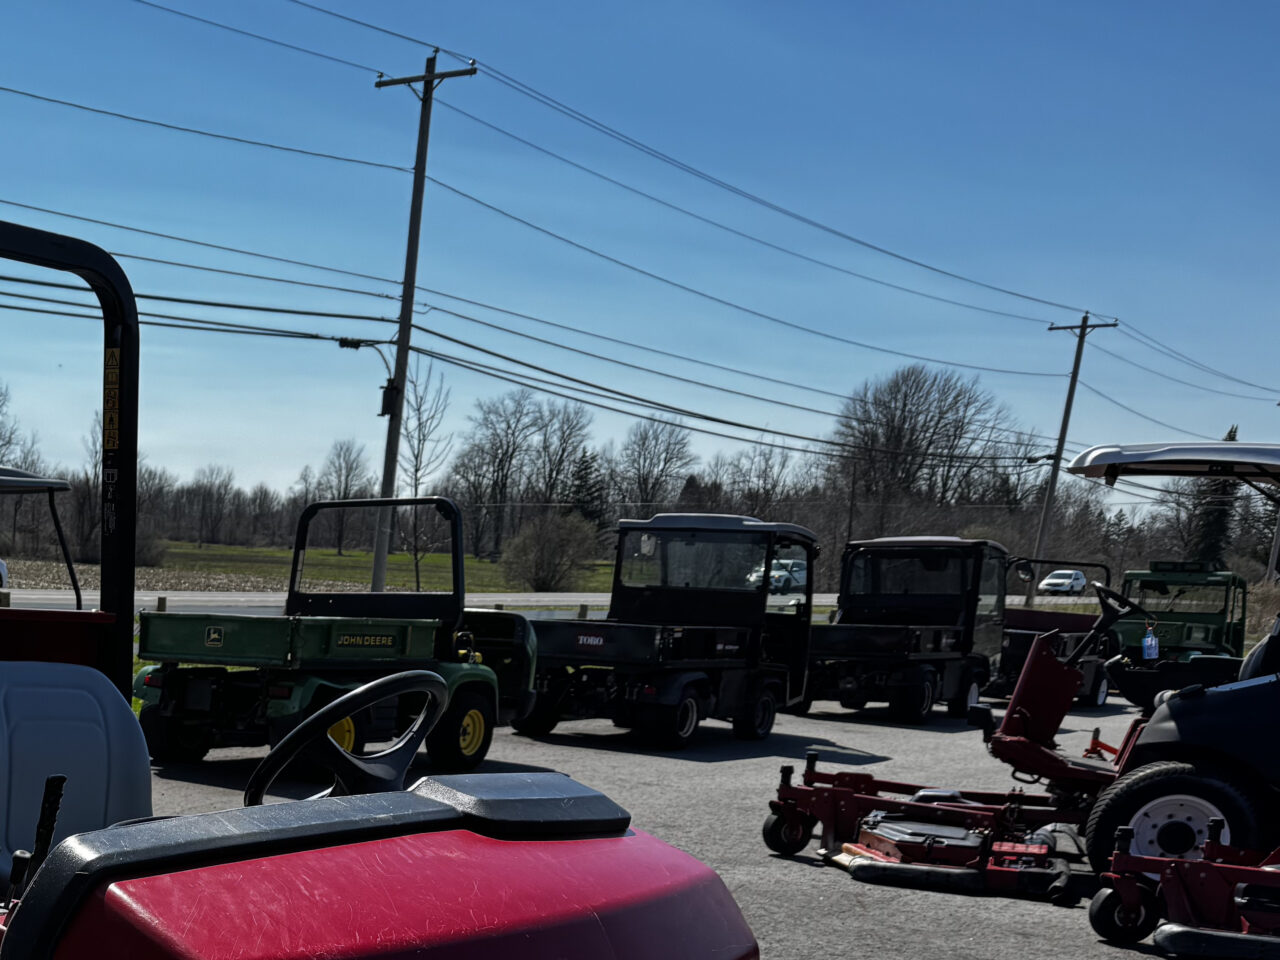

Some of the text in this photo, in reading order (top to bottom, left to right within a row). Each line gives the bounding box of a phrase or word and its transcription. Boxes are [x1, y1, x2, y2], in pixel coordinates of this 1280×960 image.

[337, 635, 393, 646] JOHN DEERE
[577, 635, 604, 646] TORO
